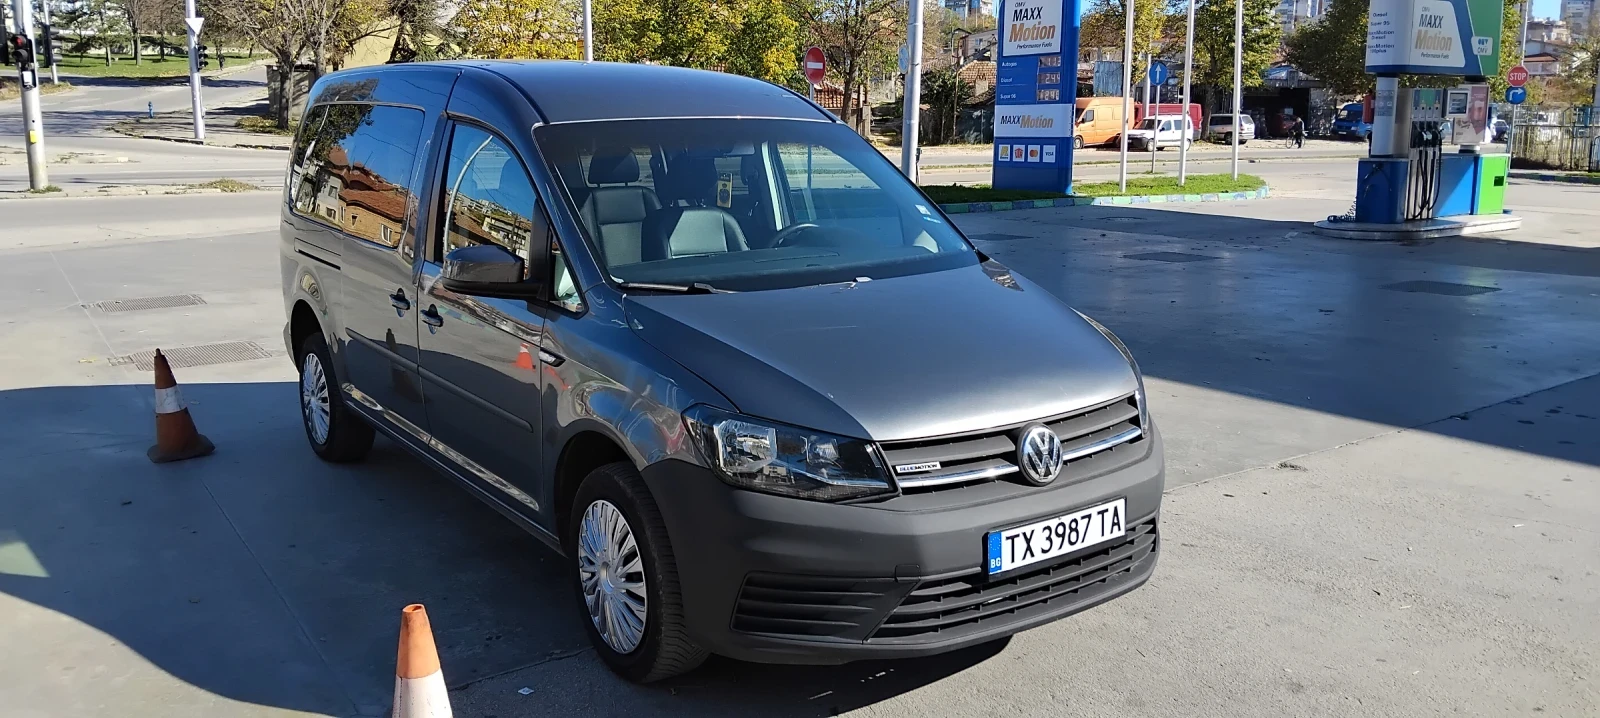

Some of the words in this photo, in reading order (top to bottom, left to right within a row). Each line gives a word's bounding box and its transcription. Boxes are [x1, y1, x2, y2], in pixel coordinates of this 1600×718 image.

[1012, 6, 1044, 22] MAXX
[1418, 14, 1444, 29] MAXX
[1008, 21, 1056, 43] Motion
[1016, 42, 1041, 50] Performance
[1414, 29, 1453, 51] Motion
[1420, 51, 1441, 59] Performance
[1509, 72, 1527, 81] STOP
[1006, 529, 1035, 564] TX
[1040, 513, 1092, 554] 3987
[1097, 505, 1122, 537] TA
[990, 557, 1001, 569] BG
